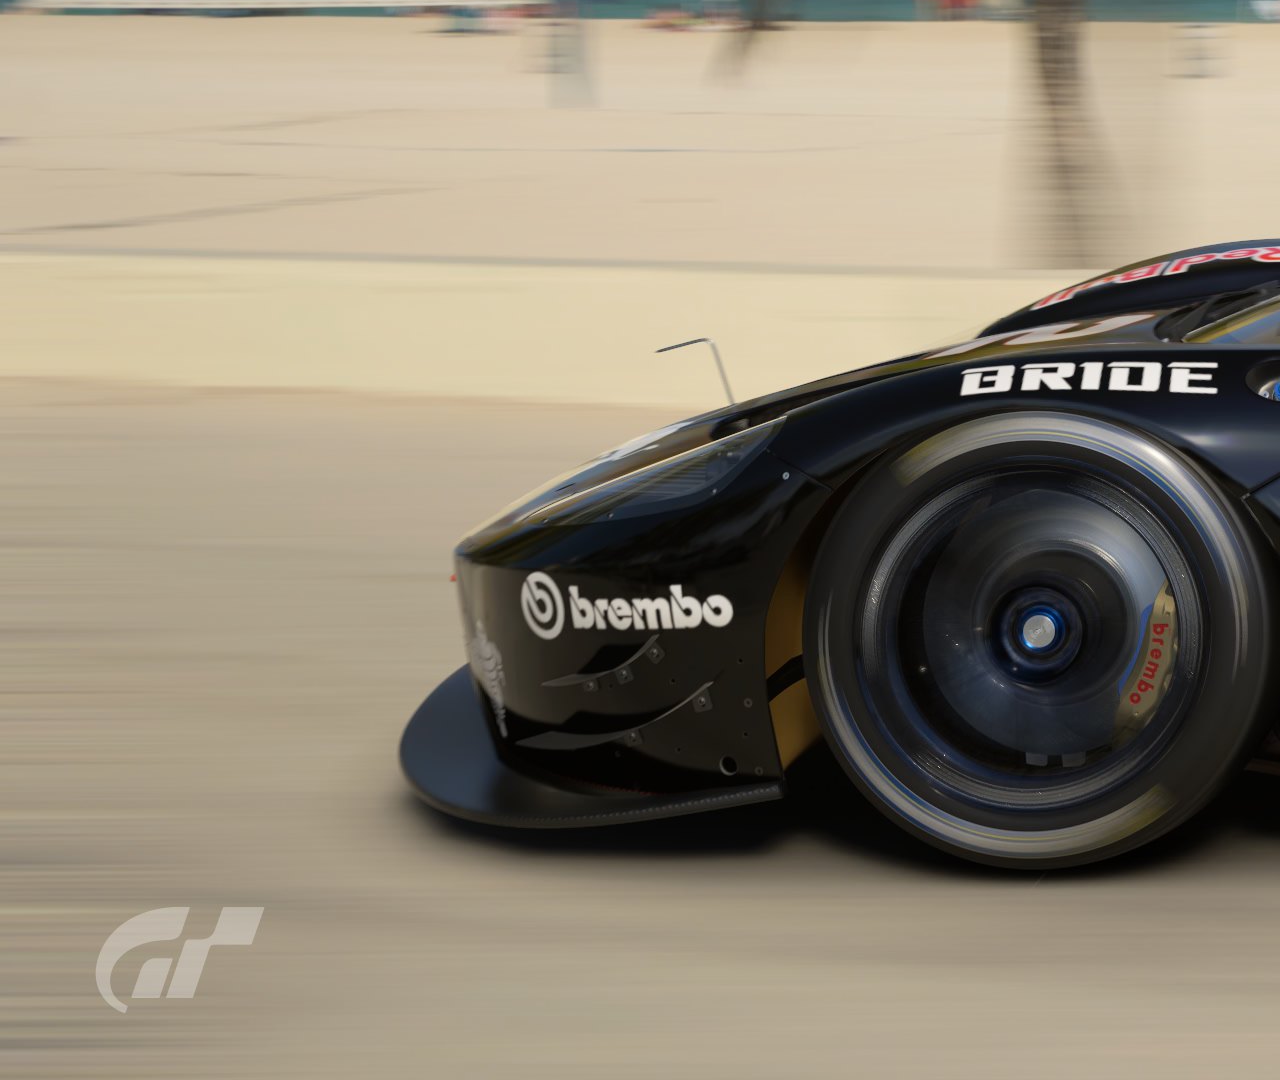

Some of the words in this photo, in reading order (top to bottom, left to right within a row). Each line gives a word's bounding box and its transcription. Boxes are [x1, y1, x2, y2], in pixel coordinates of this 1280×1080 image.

[960, 361, 1219, 396] BRIDE
[568, 584, 734, 630] brembo
[1129, 623, 1169, 705] brembo
